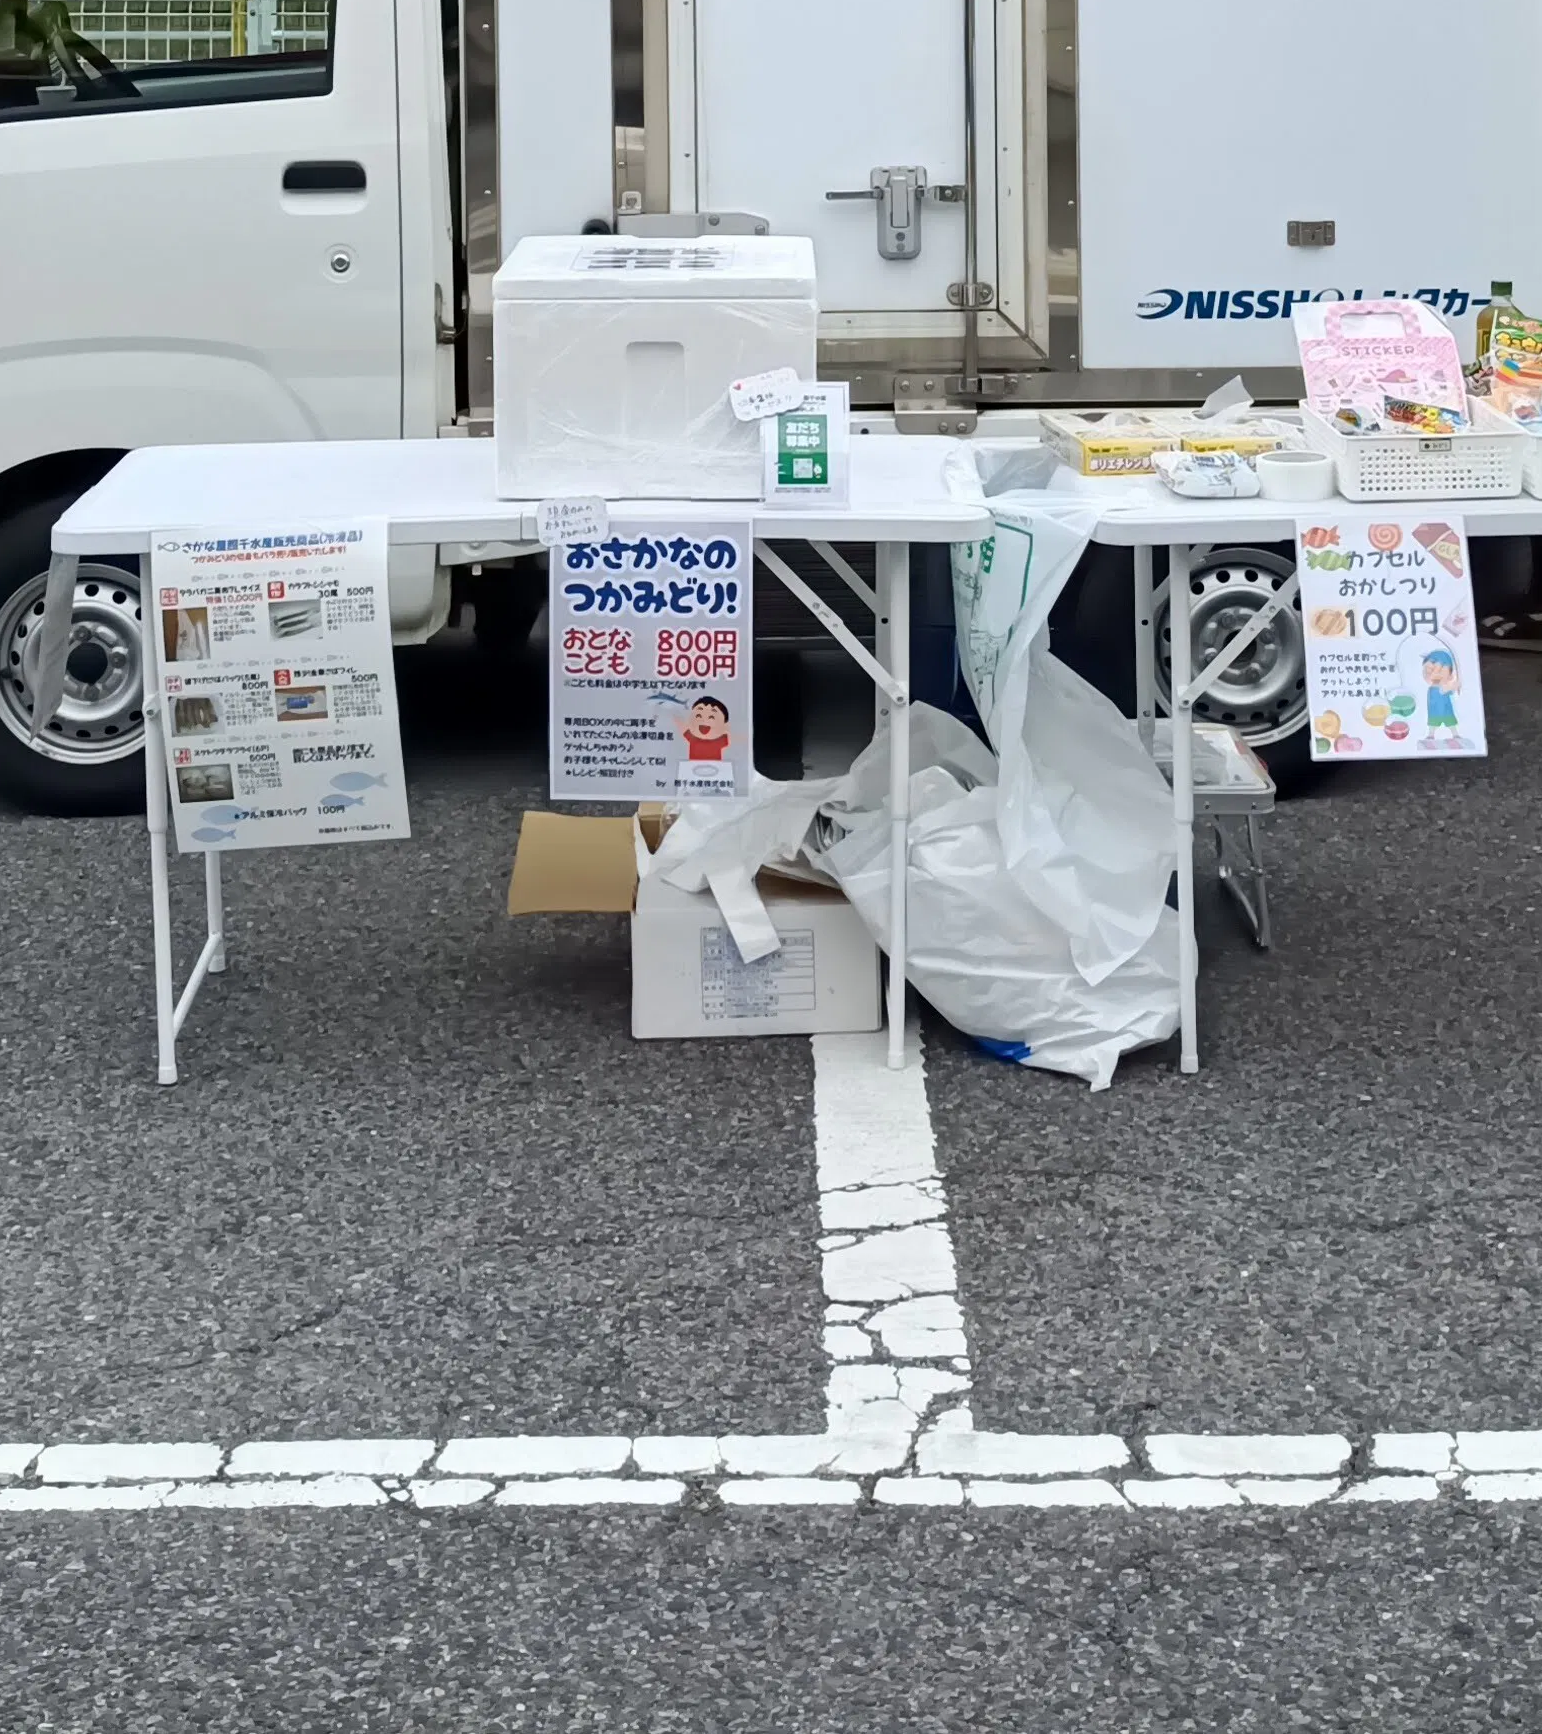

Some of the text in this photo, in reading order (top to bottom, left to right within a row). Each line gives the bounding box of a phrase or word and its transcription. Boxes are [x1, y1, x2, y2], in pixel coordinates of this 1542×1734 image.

[1341, 345, 1415, 357] STICKER
[785, 421, 820, 435] 友だち
[565, 537, 737, 570] おさかなの
[1348, 550, 1425, 569] カプセル
[346, 586, 374, 597] 500円
[564, 577, 738, 614] つかみどり!
[1339, 576, 1437, 597] おかしつり
[1344, 608, 1439, 637] 100円
[563, 628, 738, 654] おとな 800円
[564, 652, 737, 677] こども 500円
[655, 780, 666, 789] by
[317, 804, 346, 816] 100円
